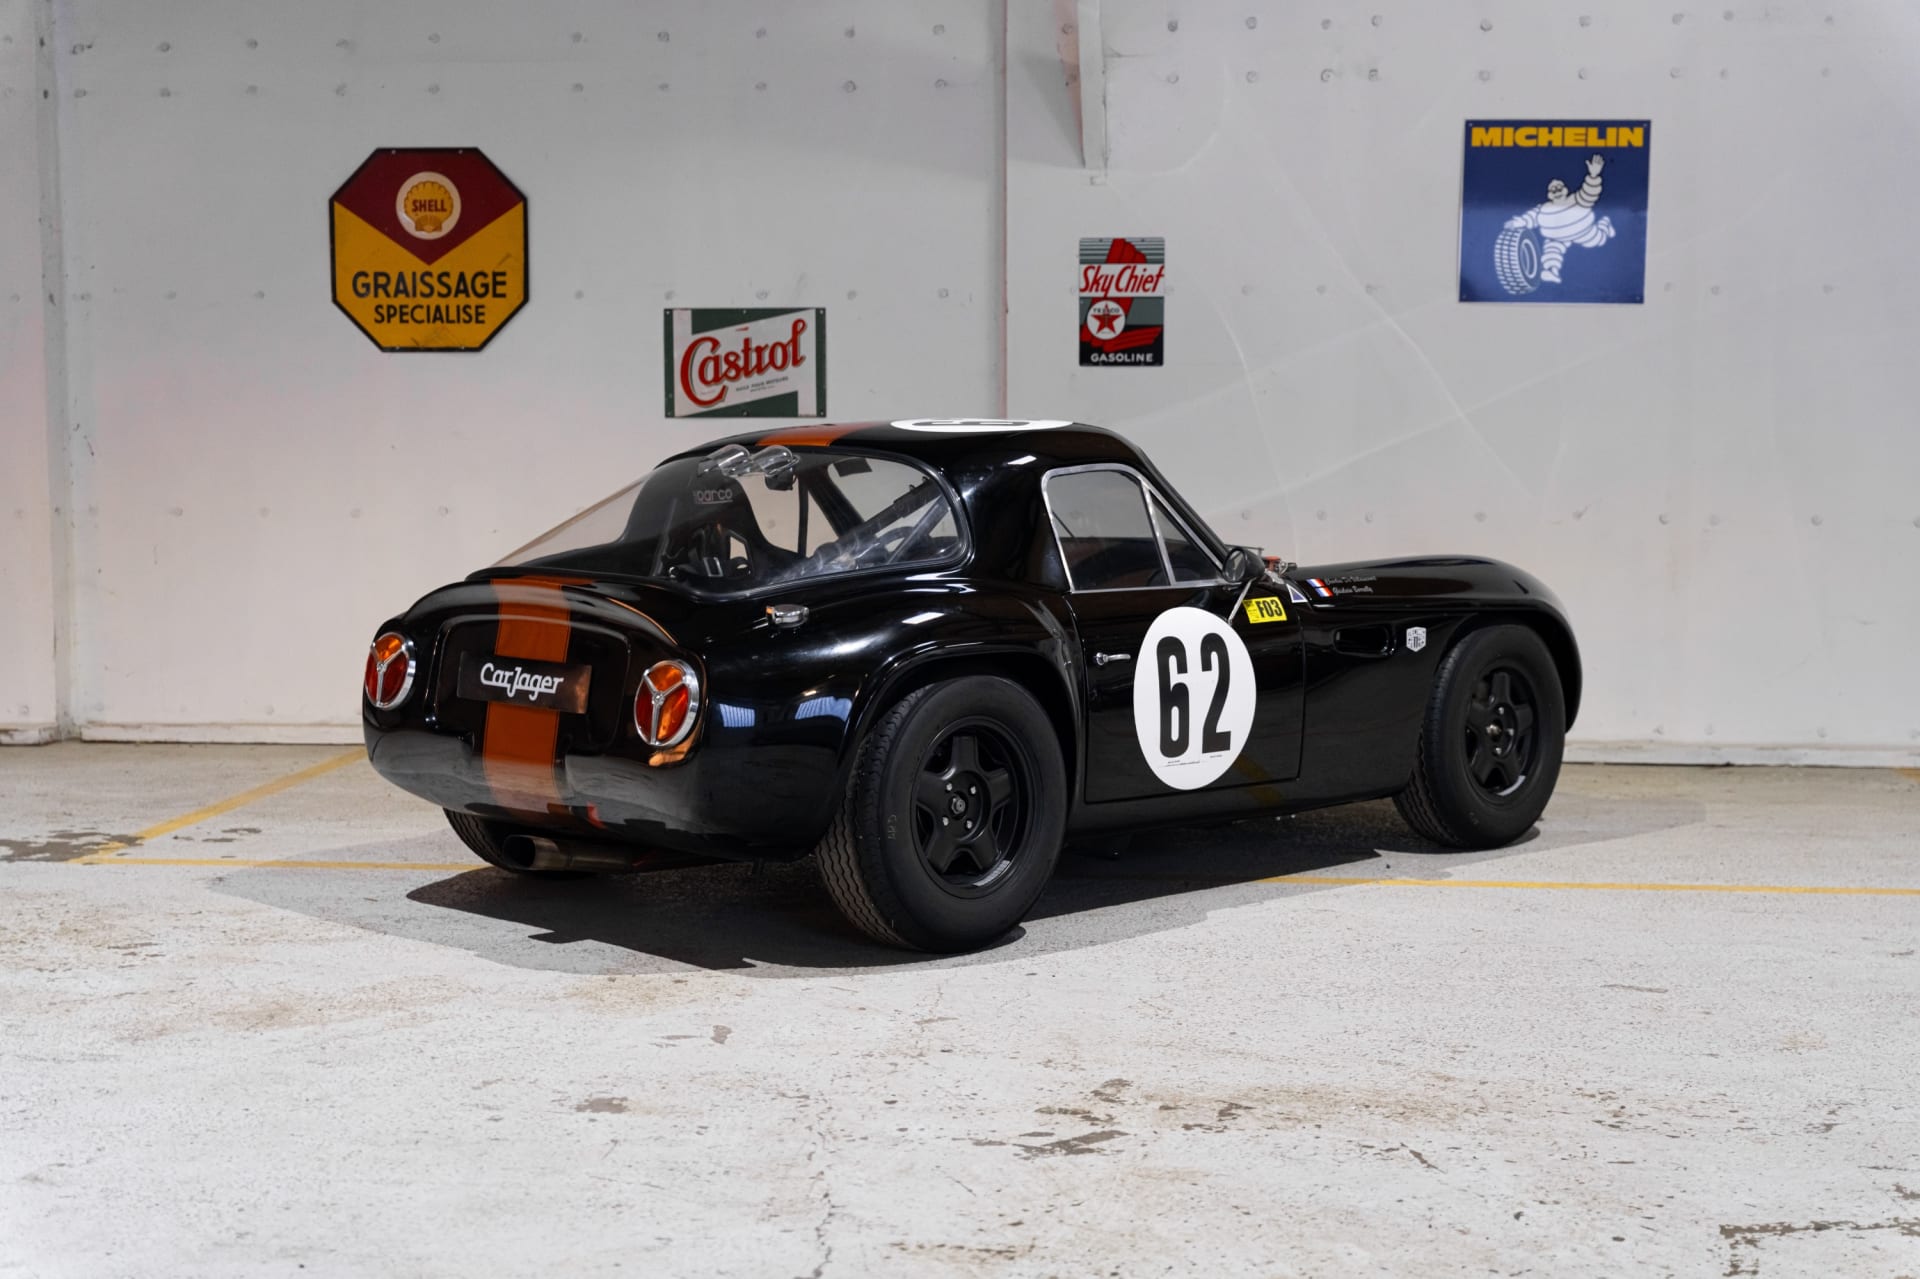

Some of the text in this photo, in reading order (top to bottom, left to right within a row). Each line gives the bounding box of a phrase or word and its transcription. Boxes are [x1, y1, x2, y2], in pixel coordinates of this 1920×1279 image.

[1471, 127, 1644, 147] MICHELIN
[411, 199, 447, 212] SHELL
[352, 271, 507, 298] GRAISSAGE
[1079, 264, 1164, 298] Sky Chief
[374, 304, 486, 324] SPECIALISE
[680, 318, 807, 408] Castrol
[1090, 353, 1153, 363] GASOLINE
[480, 662, 564, 701] CarJager
[1156, 632, 1232, 758] 62
